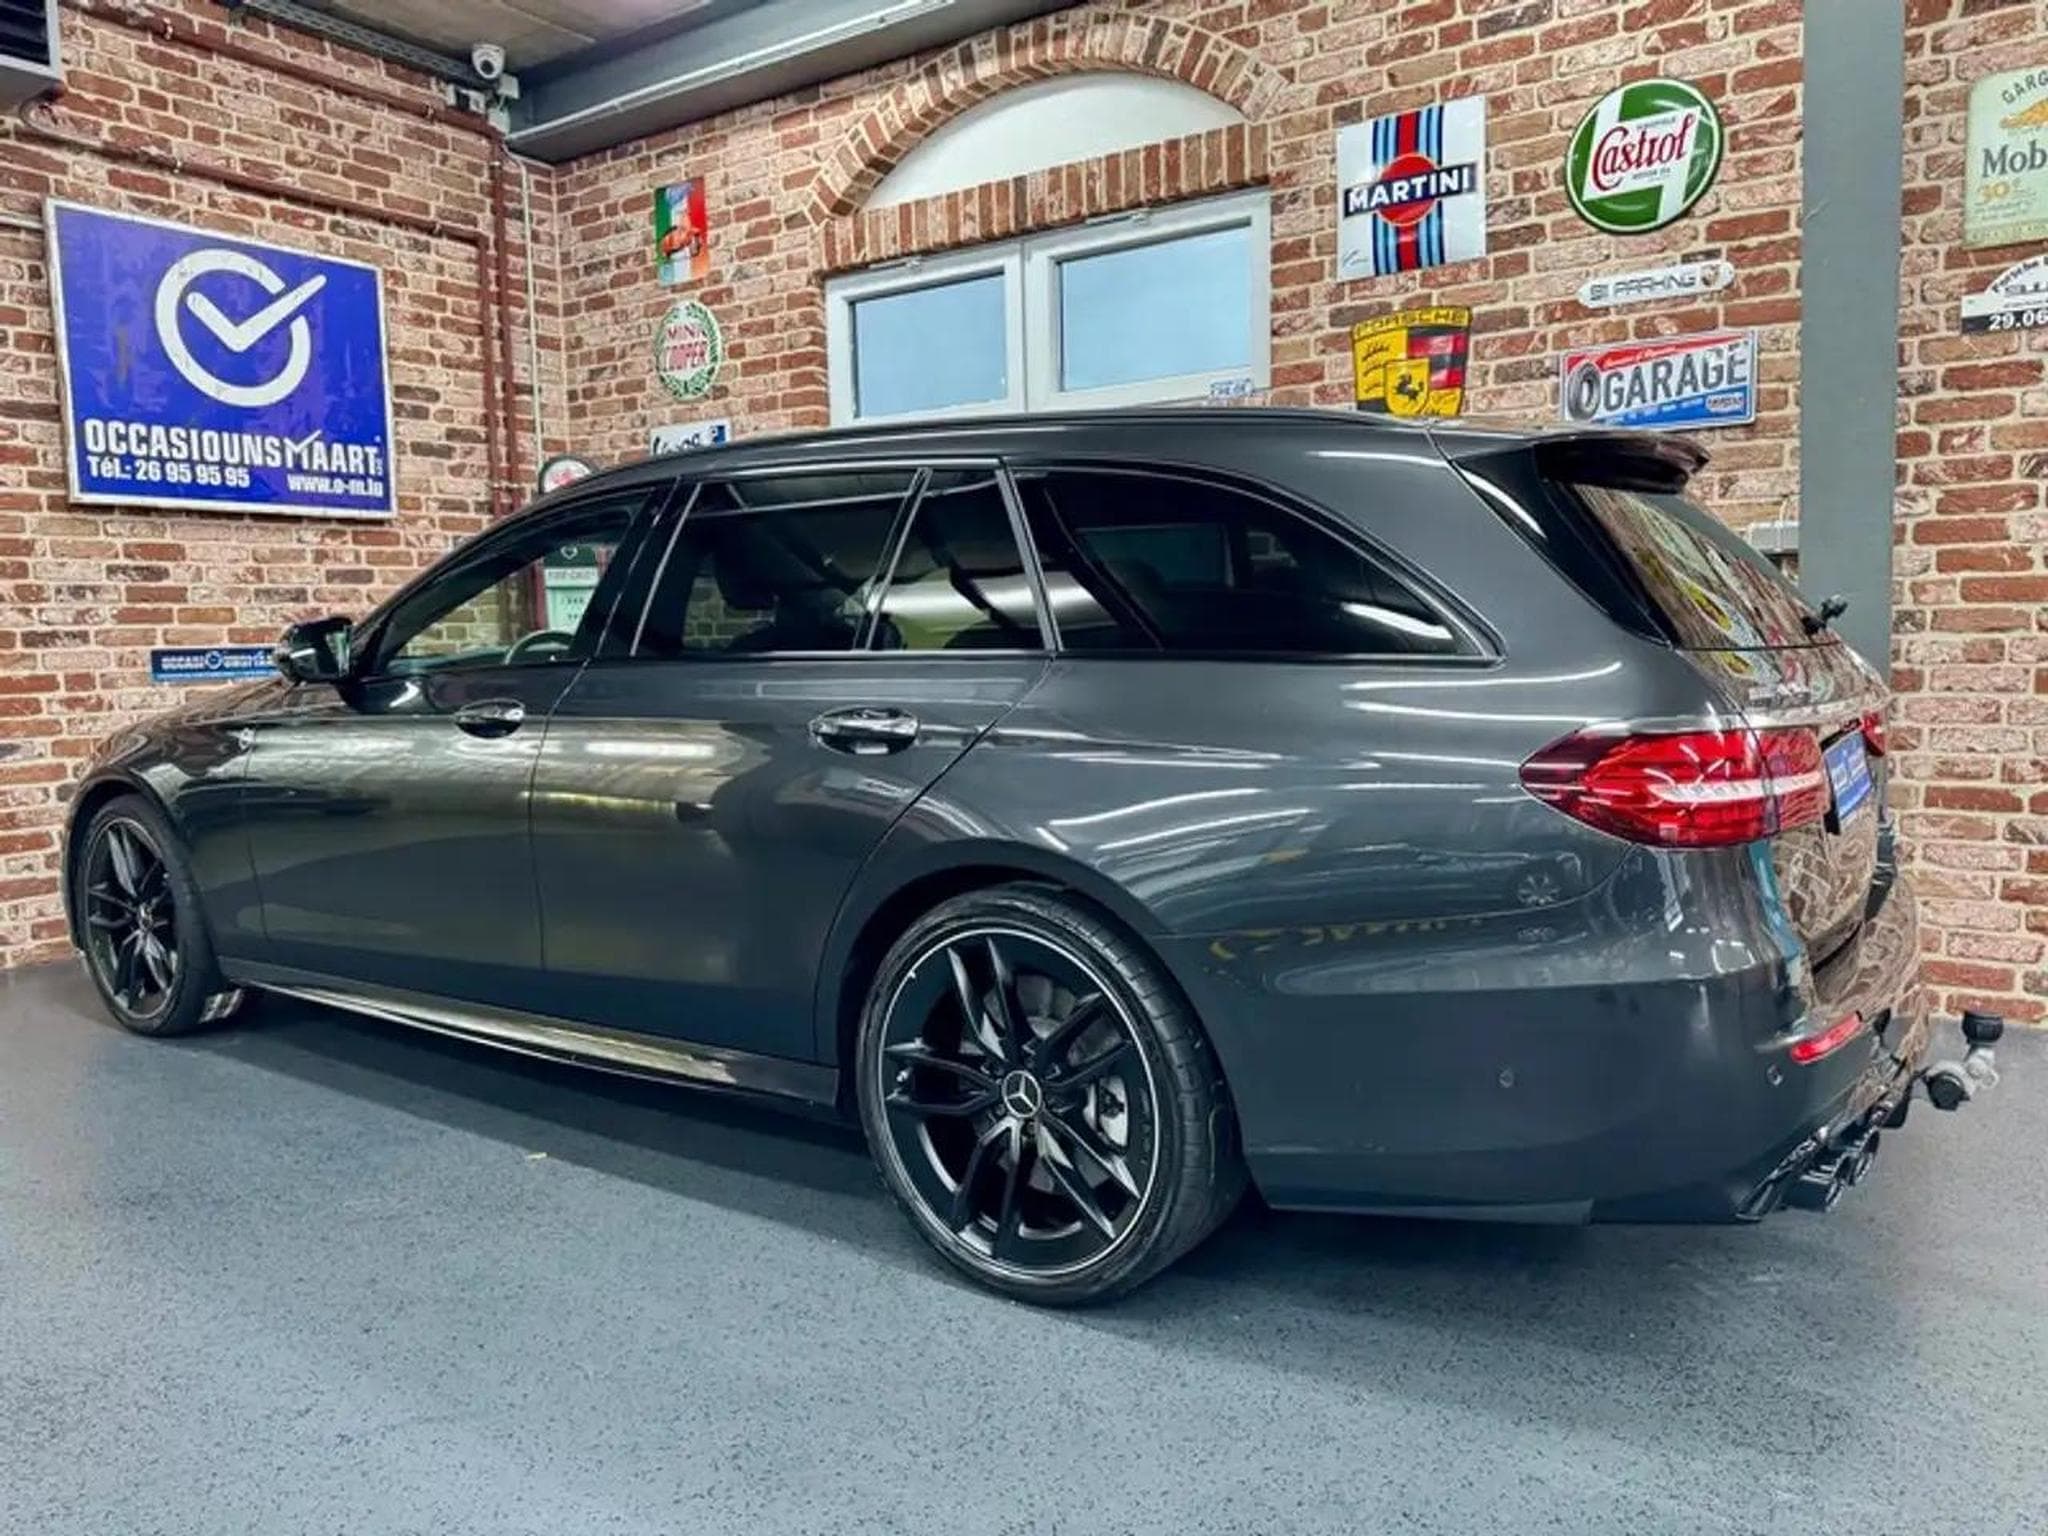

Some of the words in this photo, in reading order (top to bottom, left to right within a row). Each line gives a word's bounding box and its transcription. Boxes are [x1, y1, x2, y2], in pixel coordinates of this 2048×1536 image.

[1592, 112, 1695, 192] Castrol
[1982, 138, 2047, 178] Mob
[1348, 167, 1470, 212] MARTINI
[1613, 273, 1697, 297] PARKING
[1354, 307, 1468, 337] PORSCHE
[1603, 340, 1749, 412] GARAGE
[84, 418, 379, 475] OCCASIOUNSMAART
[134, 459, 161, 481] 26
[166, 462, 192, 484] 95
[196, 464, 222, 486] 95
[224, 466, 251, 488] 95
[287, 473, 384, 497] www.o-m.lu
